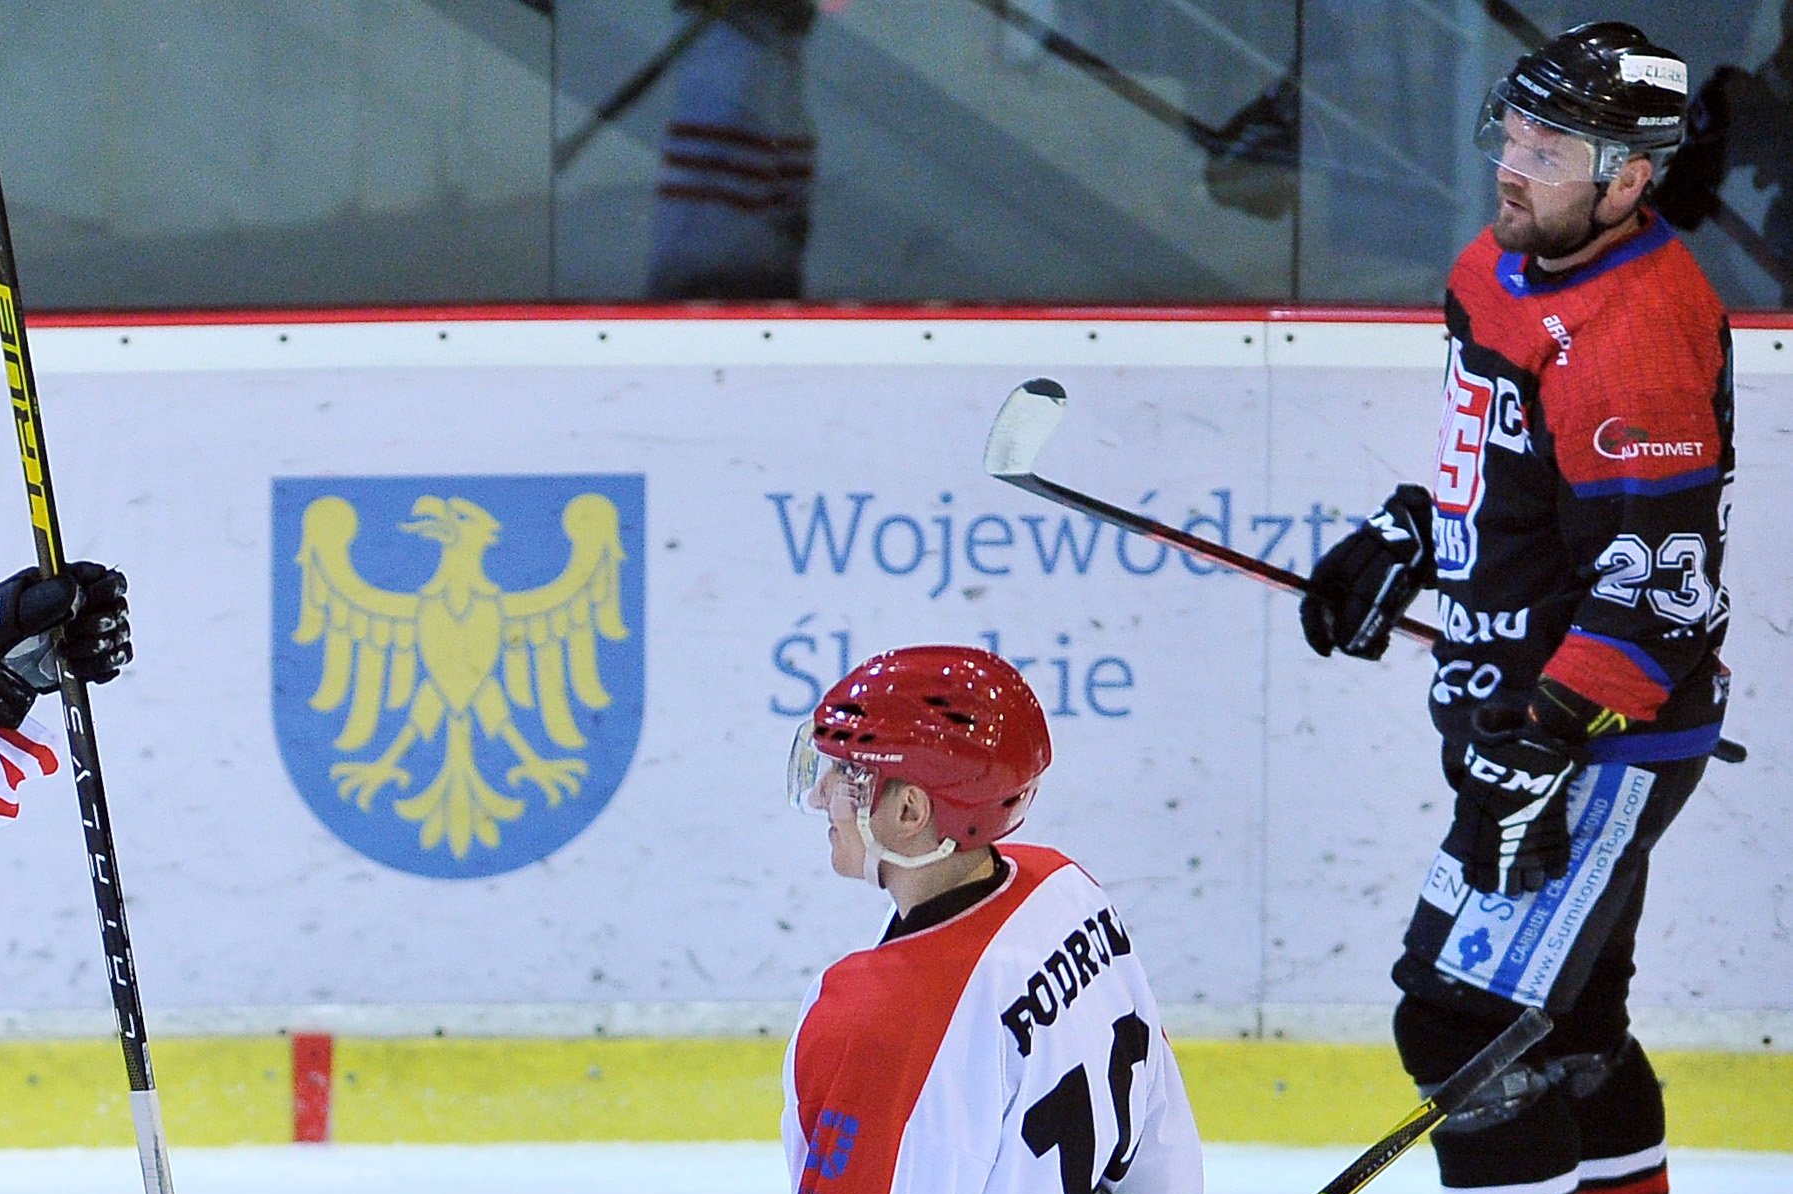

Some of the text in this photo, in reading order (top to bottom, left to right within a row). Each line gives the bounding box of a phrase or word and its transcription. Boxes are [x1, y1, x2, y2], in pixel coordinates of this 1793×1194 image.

[1636, 115, 1681, 127] BAUER
[1620, 442, 1704, 459] AUTOMET
[765, 490, 1366, 599] Województ
[1592, 532, 1714, 625] 23
[850, 750, 904, 763] TRUE
